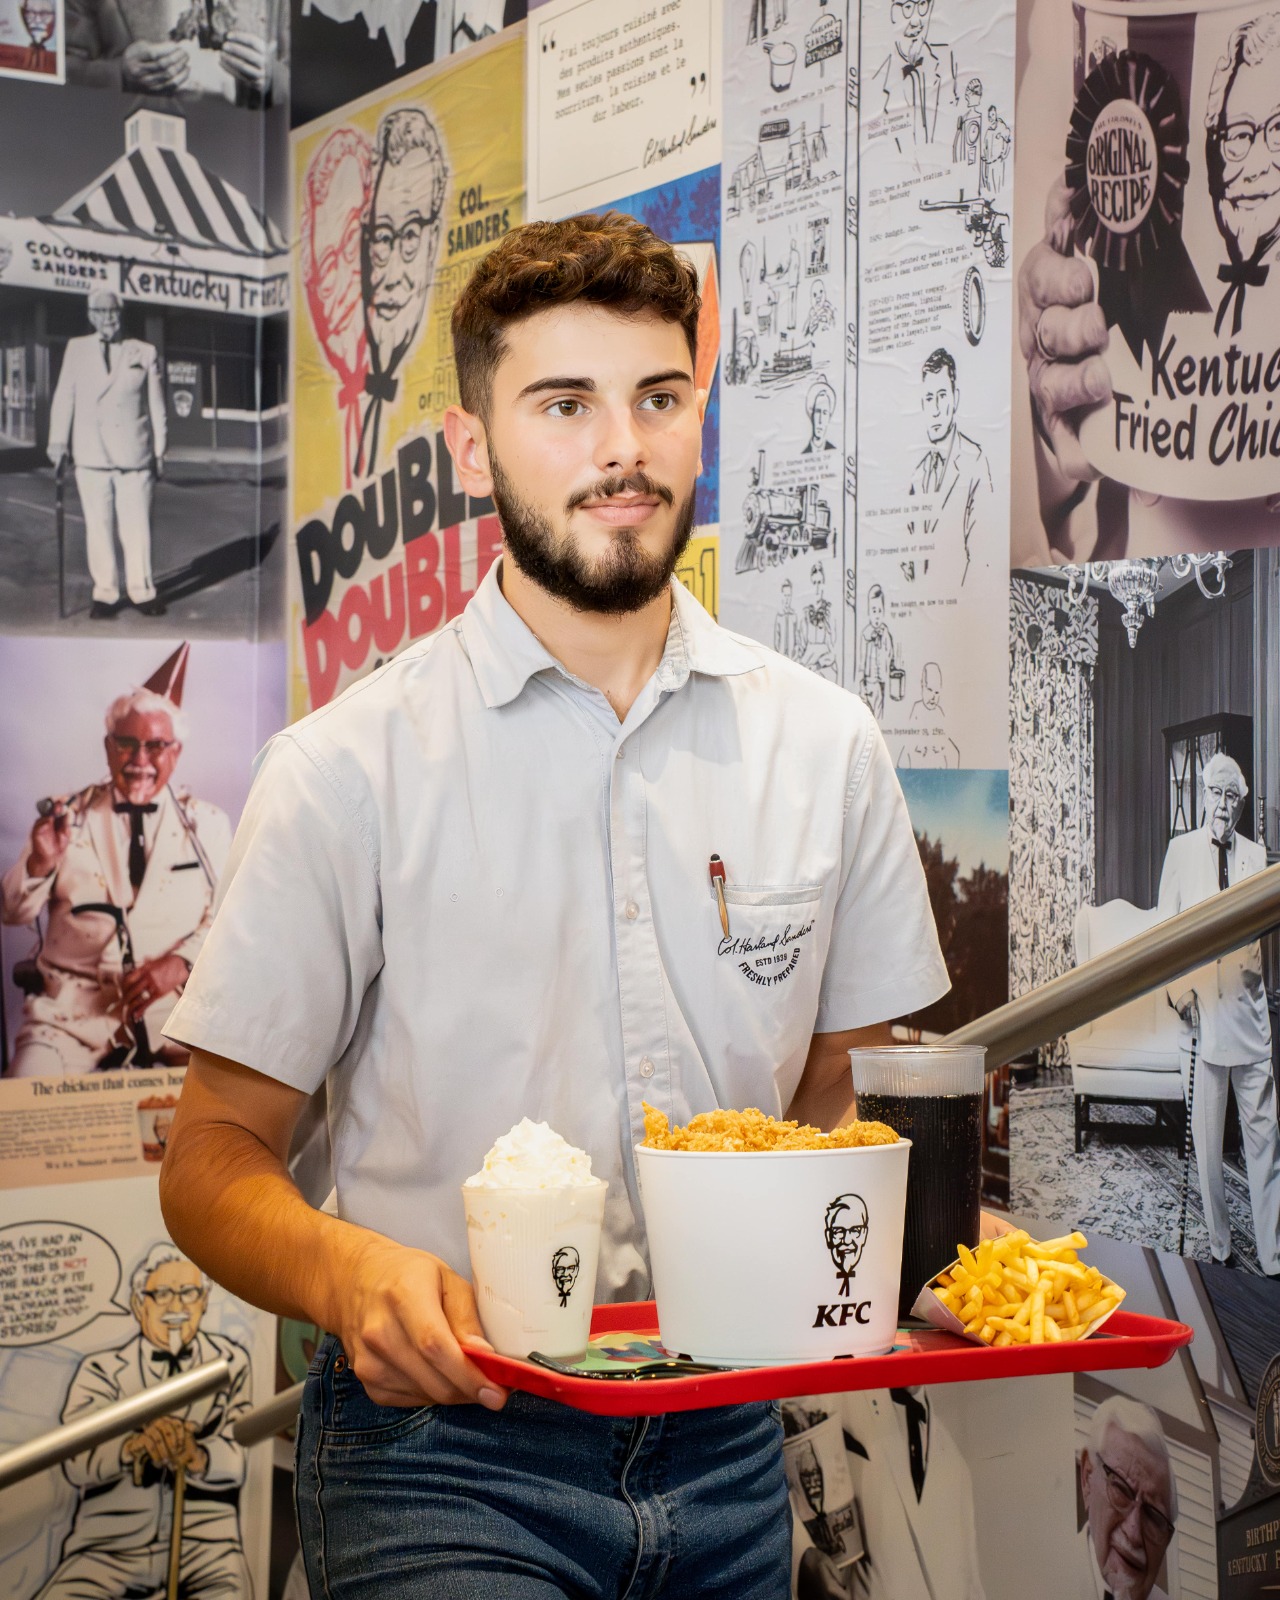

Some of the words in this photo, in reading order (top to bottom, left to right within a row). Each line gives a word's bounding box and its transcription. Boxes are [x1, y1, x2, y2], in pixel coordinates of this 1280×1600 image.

[582, 28, 618, 51] toujours
[576, 50, 614, 76] produits
[606, 56, 644, 82] passions
[648, 45, 668, 61] sont
[672, 38, 684, 50] la
[610, 86, 619, 98] la
[660, 64, 670, 76] et
[676, 57, 686, 70] le
[847, 66, 858, 111] 1940
[1088, 127, 1152, 176] ORIGINAL
[459, 185, 490, 217] COL.
[846, 195, 858, 240] 1930
[1091, 175, 1151, 223] RECIPE
[447, 208, 510, 256] SANDERS
[32, 258, 108, 280] SANDERS
[119, 257, 230, 310] Kentucky
[846, 323, 858, 370] 1920
[1112, 390, 1198, 462] Fried
[845, 456, 857, 500] 1910
[296, 430, 499, 628] DOUBL
[845, 568, 857, 611] 1900
[738, 934, 780, 955] Harland
[755, 956, 772, 968] ESTD
[738, 961, 772, 987] FRESHLY
[773, 947, 801, 985] PREPARED
[32, 1082, 53, 1096] The
[56, 1080, 100, 1094] chicken
[102, 1078, 124, 1090] that
[128, 1076, 164, 1088] comes
[68, 1232, 83, 1243] AN
[22, 1262, 44, 1274] THIS
[49, 1261, 60, 1272] IS
[63, 1257, 87, 1269] NOT
[22, 1274, 47, 1287] HALF
[52, 1272, 66, 1285] OF
[812, 1300, 872, 1328] KFC
[1228, 1553, 1268, 1576] KENTUCKY
